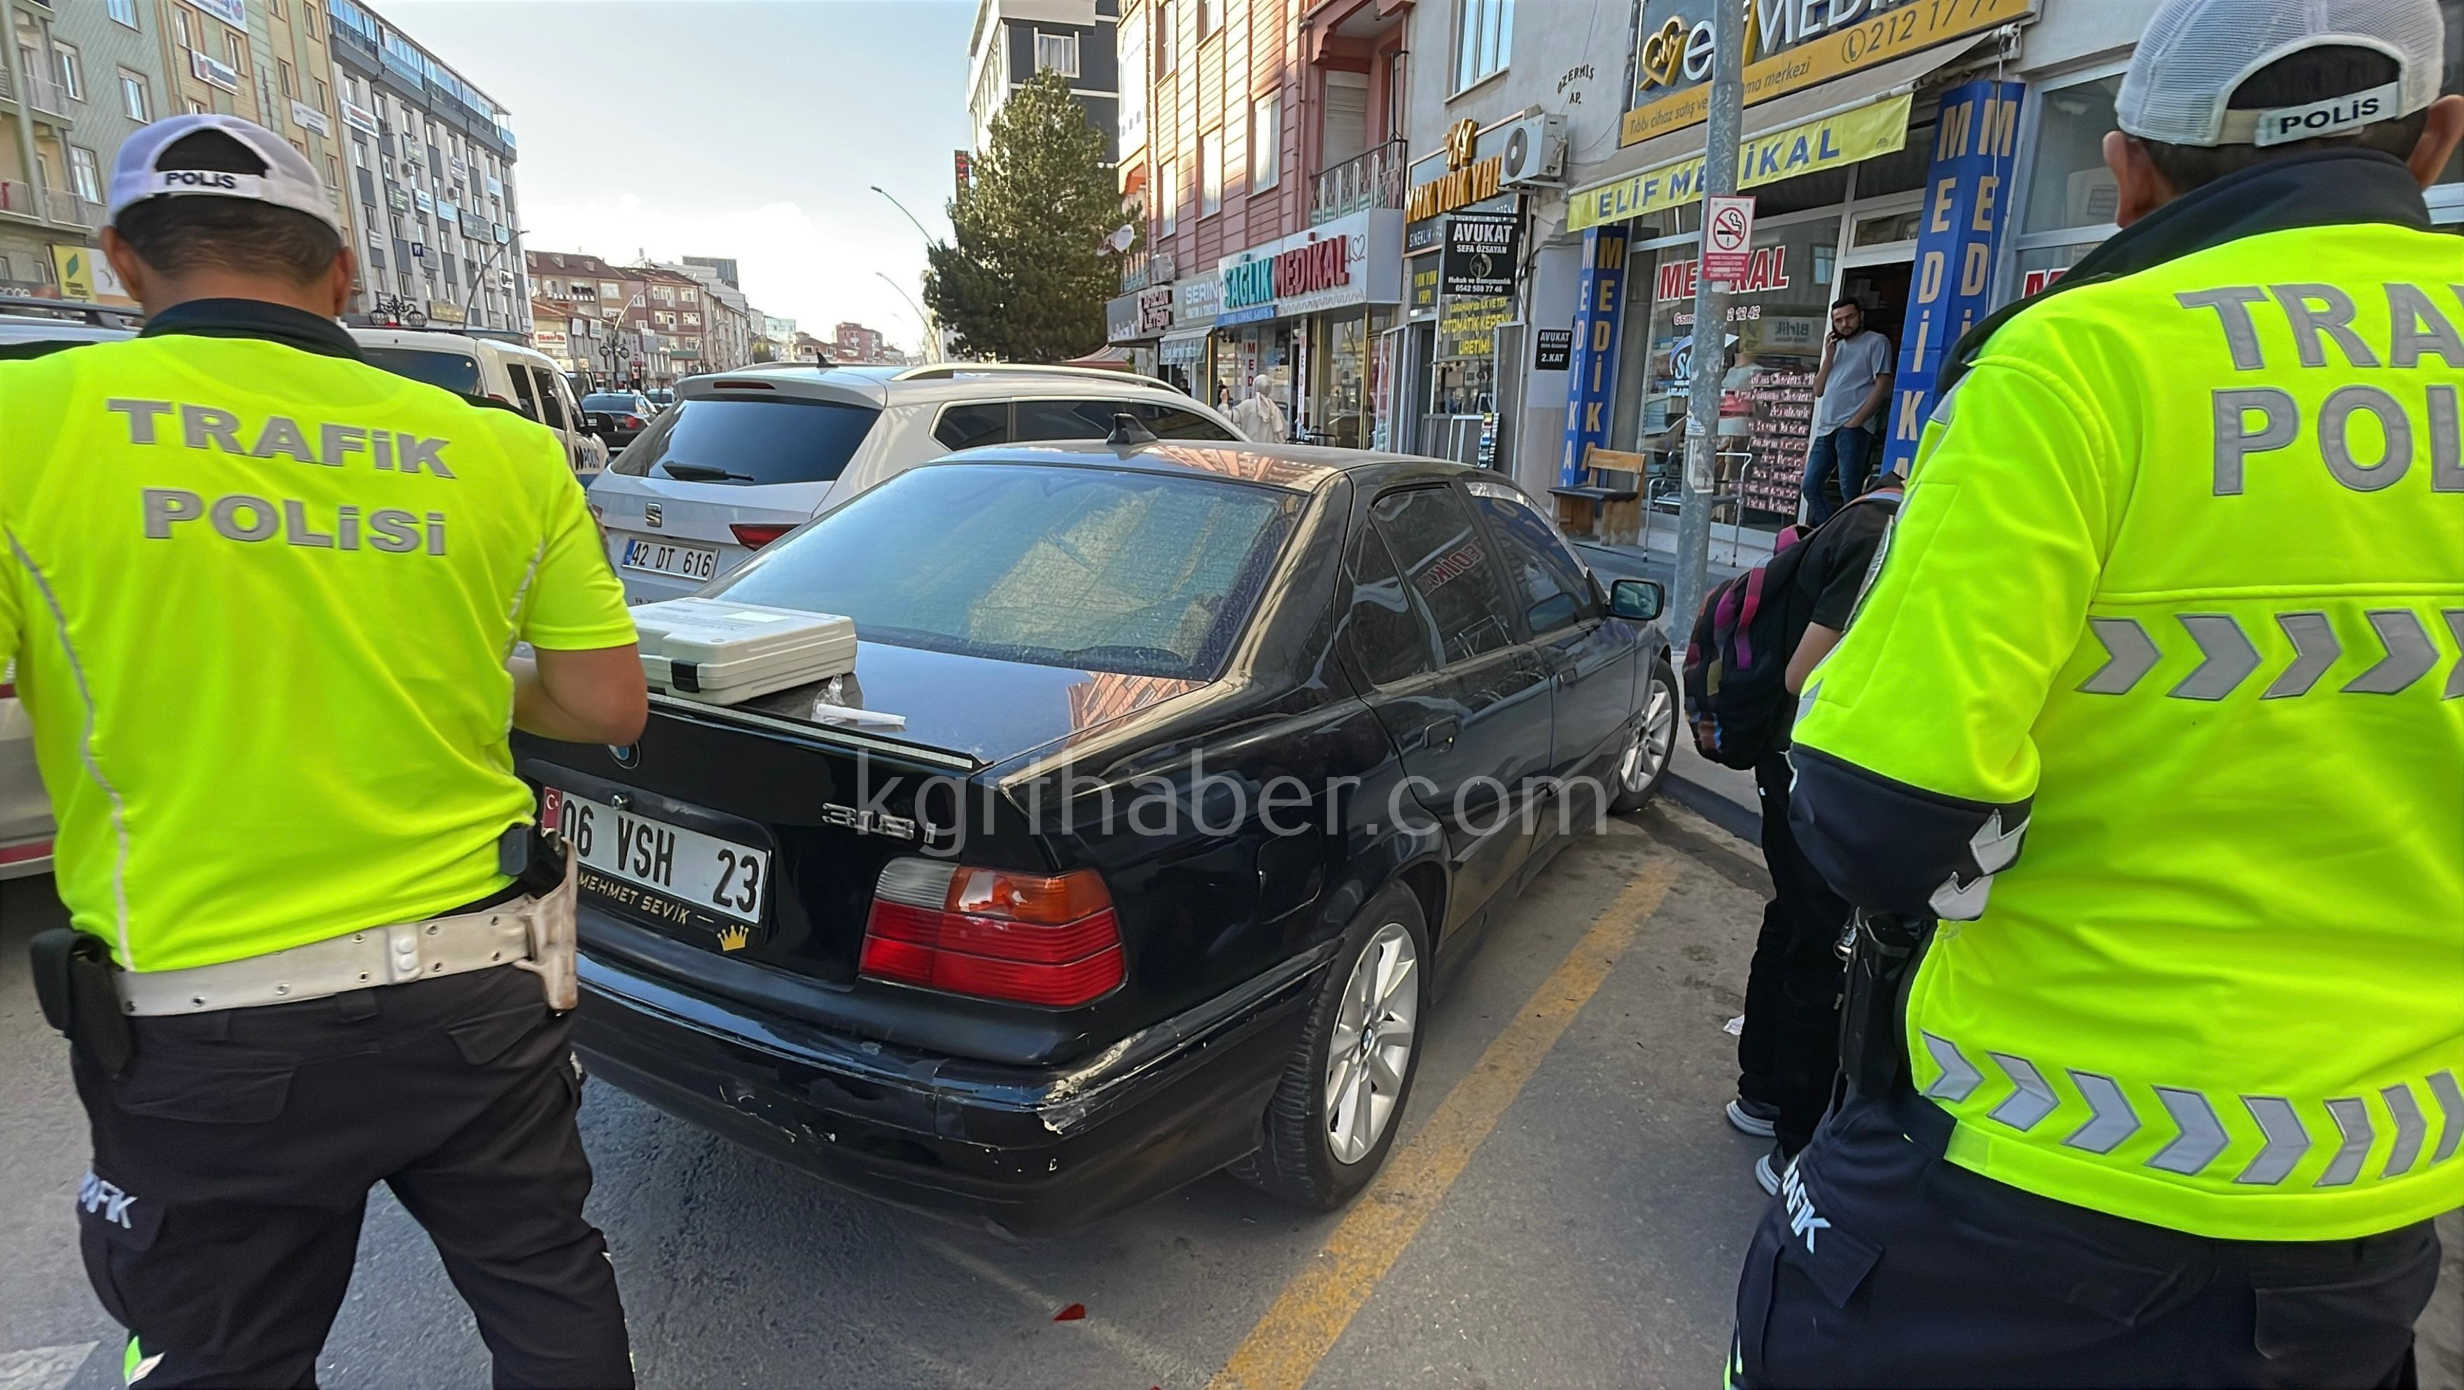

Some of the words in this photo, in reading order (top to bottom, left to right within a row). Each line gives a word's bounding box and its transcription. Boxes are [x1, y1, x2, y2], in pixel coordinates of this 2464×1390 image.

[1866, 10, 1917, 53] 212
[1764, 56, 1812, 92] merkezi
[1598, 177, 1659, 218] ELİF
[1669, 128, 1841, 201] MEİKAL
[1453, 223, 1513, 243] AVUKAT
[1456, 244, 1475, 253] SEFA
[1222, 253, 1274, 309] SAĞLIK
[1272, 232, 1351, 301] MEDİKAL
[1540, 332, 1570, 342] AVUKAT
[2174, 282, 2464, 372] TRA
[1541, 353, 1564, 362] 2.KAT
[631, 541, 649, 567] 42
[656, 546, 675, 568] DT
[683, 551, 713, 577] 616
[562, 799, 595, 858] 06
[617, 815, 676, 888] VSH
[712, 848, 760, 914] 23
[577, 871, 639, 905] MEHMET
[641, 895, 689, 926] SEVİK
